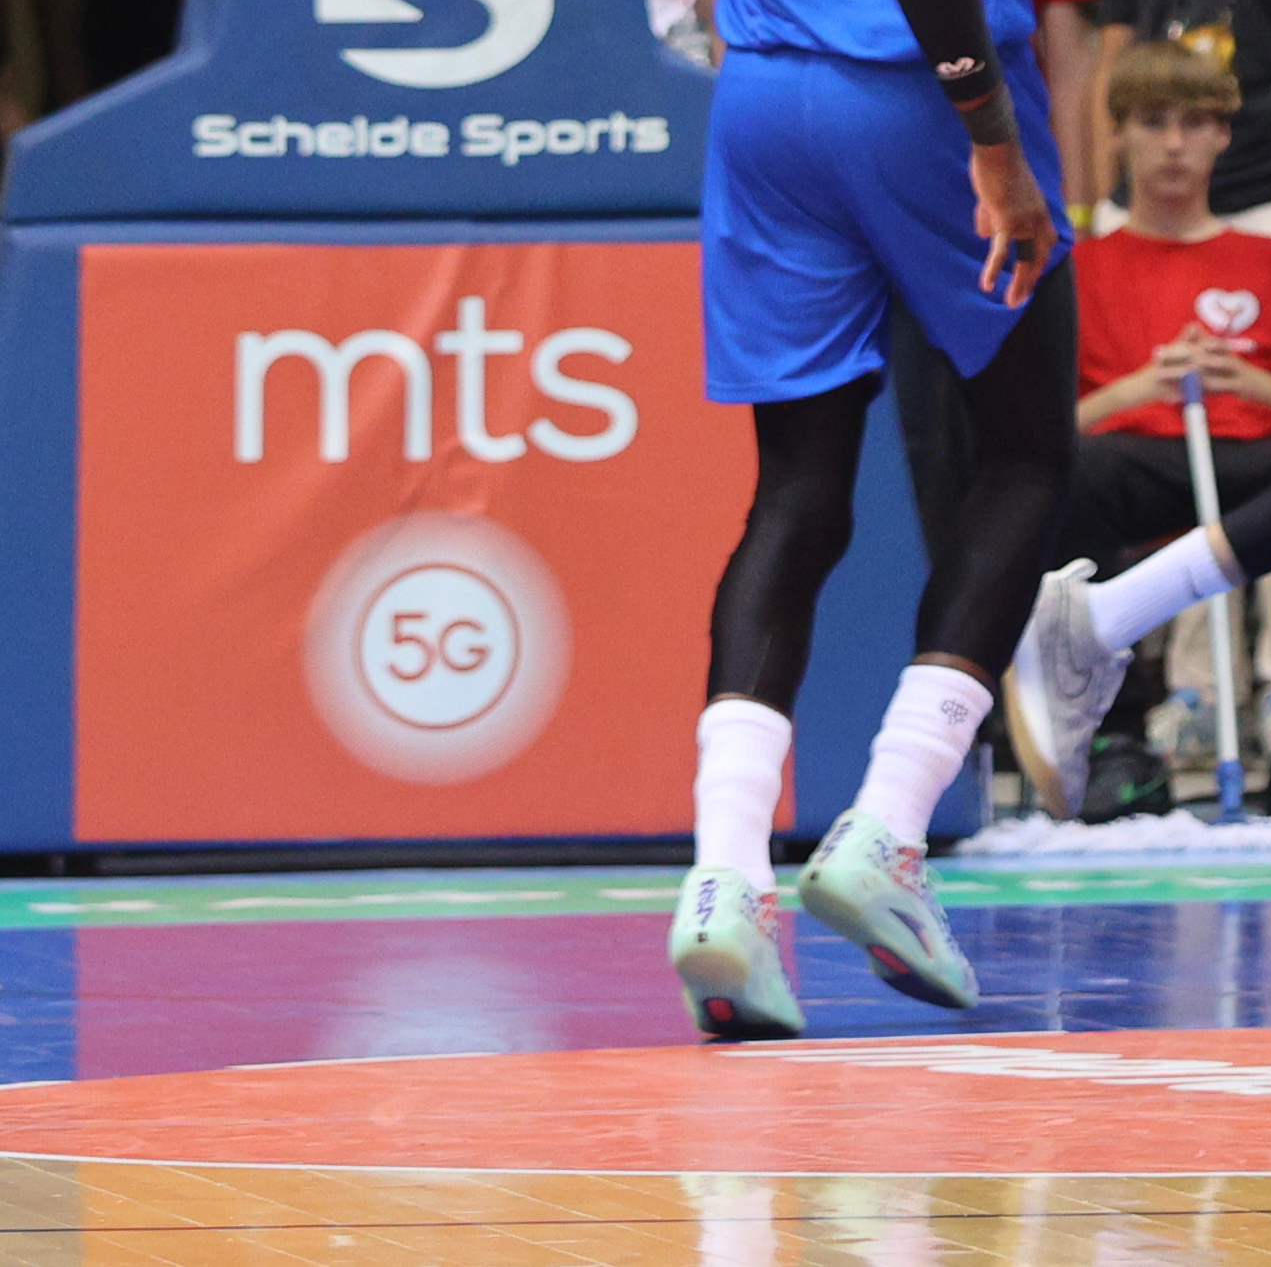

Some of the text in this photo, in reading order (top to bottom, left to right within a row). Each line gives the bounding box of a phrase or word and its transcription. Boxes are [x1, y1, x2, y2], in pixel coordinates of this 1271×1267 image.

[193, 111, 670, 166] Schelde Sports
[234, 295, 640, 463] mts
[383, 611, 491, 683] 5G
